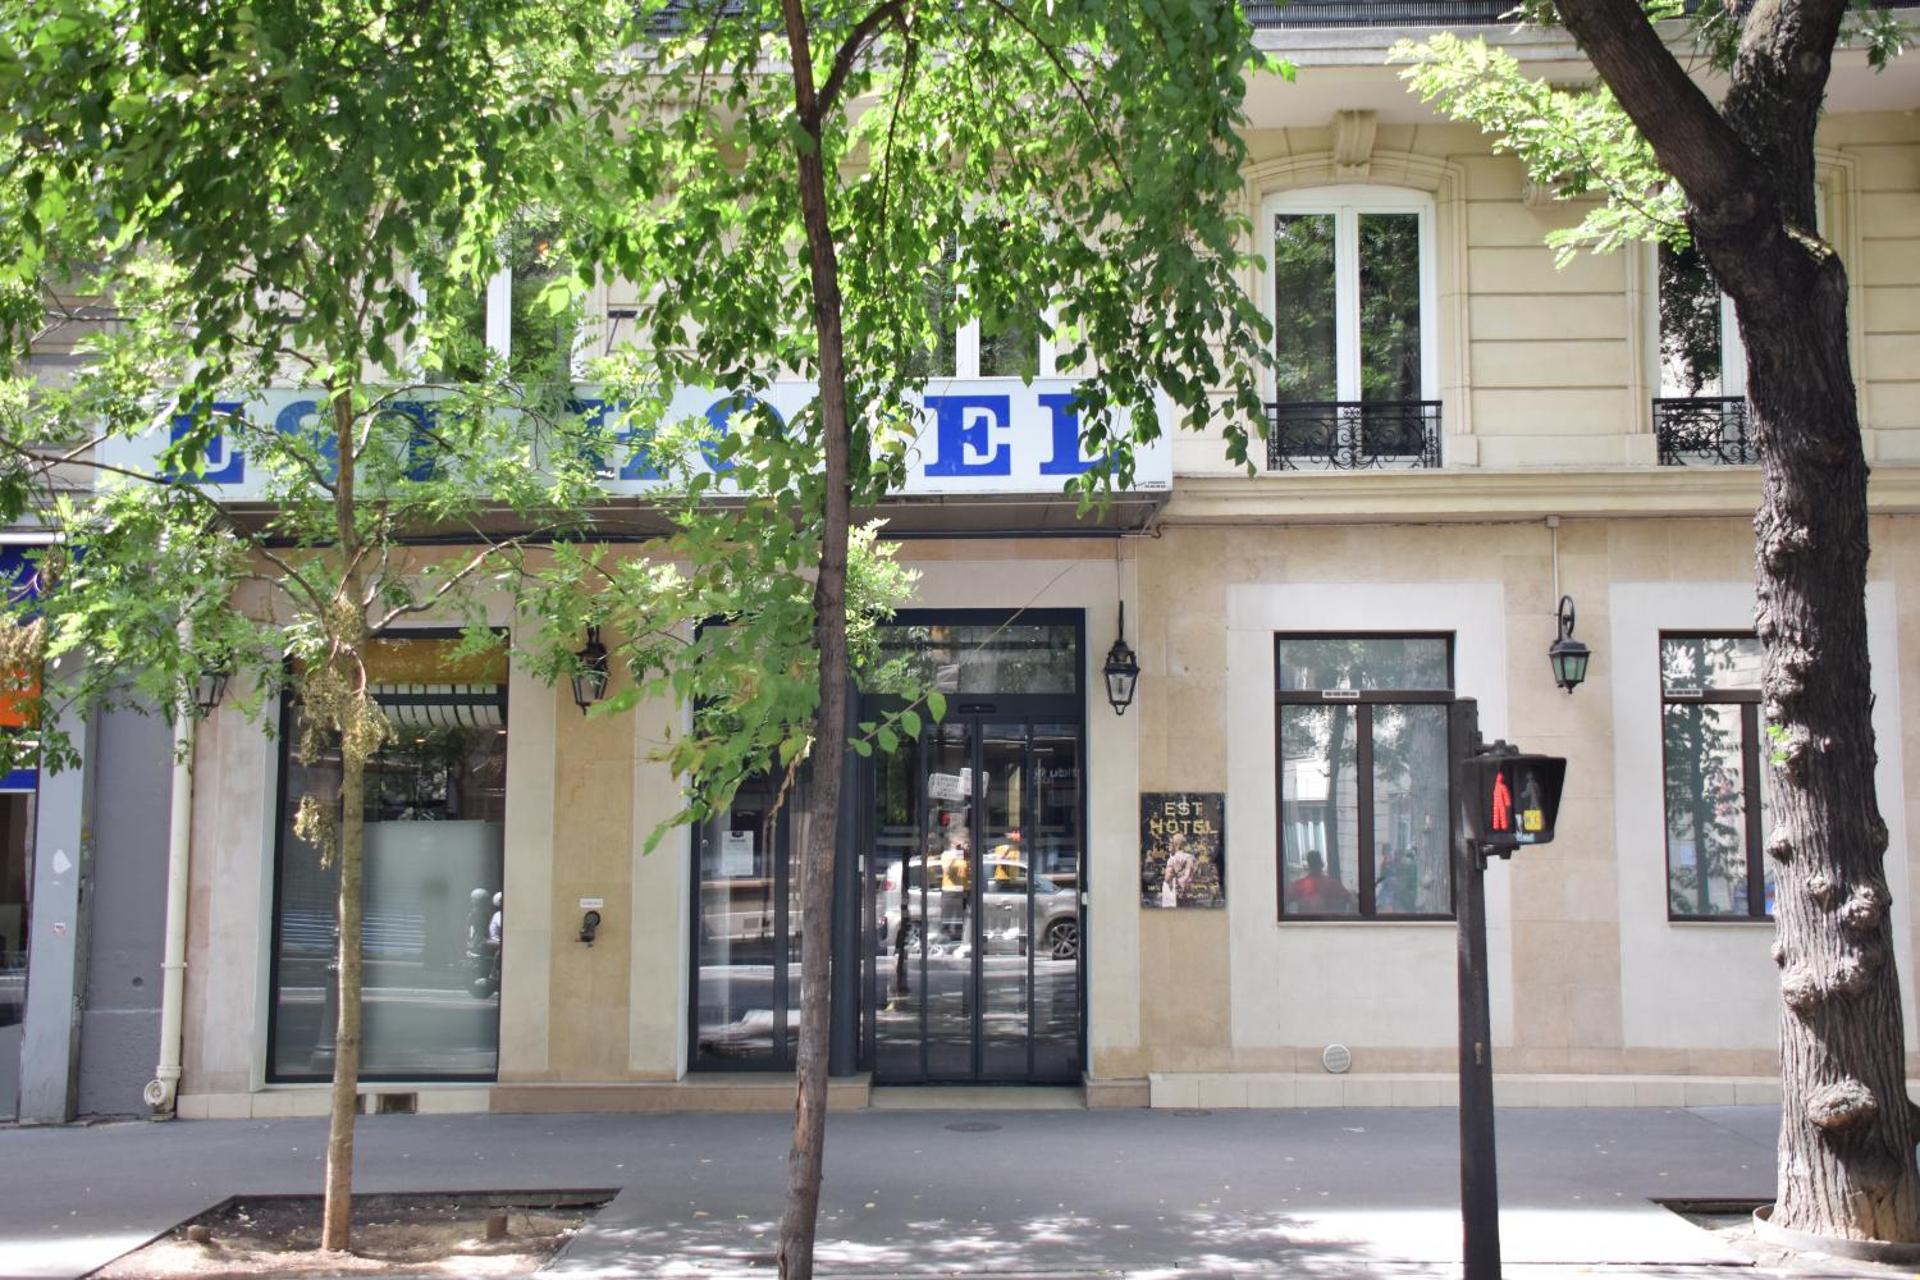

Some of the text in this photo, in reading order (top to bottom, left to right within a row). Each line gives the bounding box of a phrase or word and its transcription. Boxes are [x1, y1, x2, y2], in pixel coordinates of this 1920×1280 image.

[564, 393, 1121, 482] HOEL
[1164, 801, 1203, 816] EST
[1149, 818, 1219, 835] HOTEL
